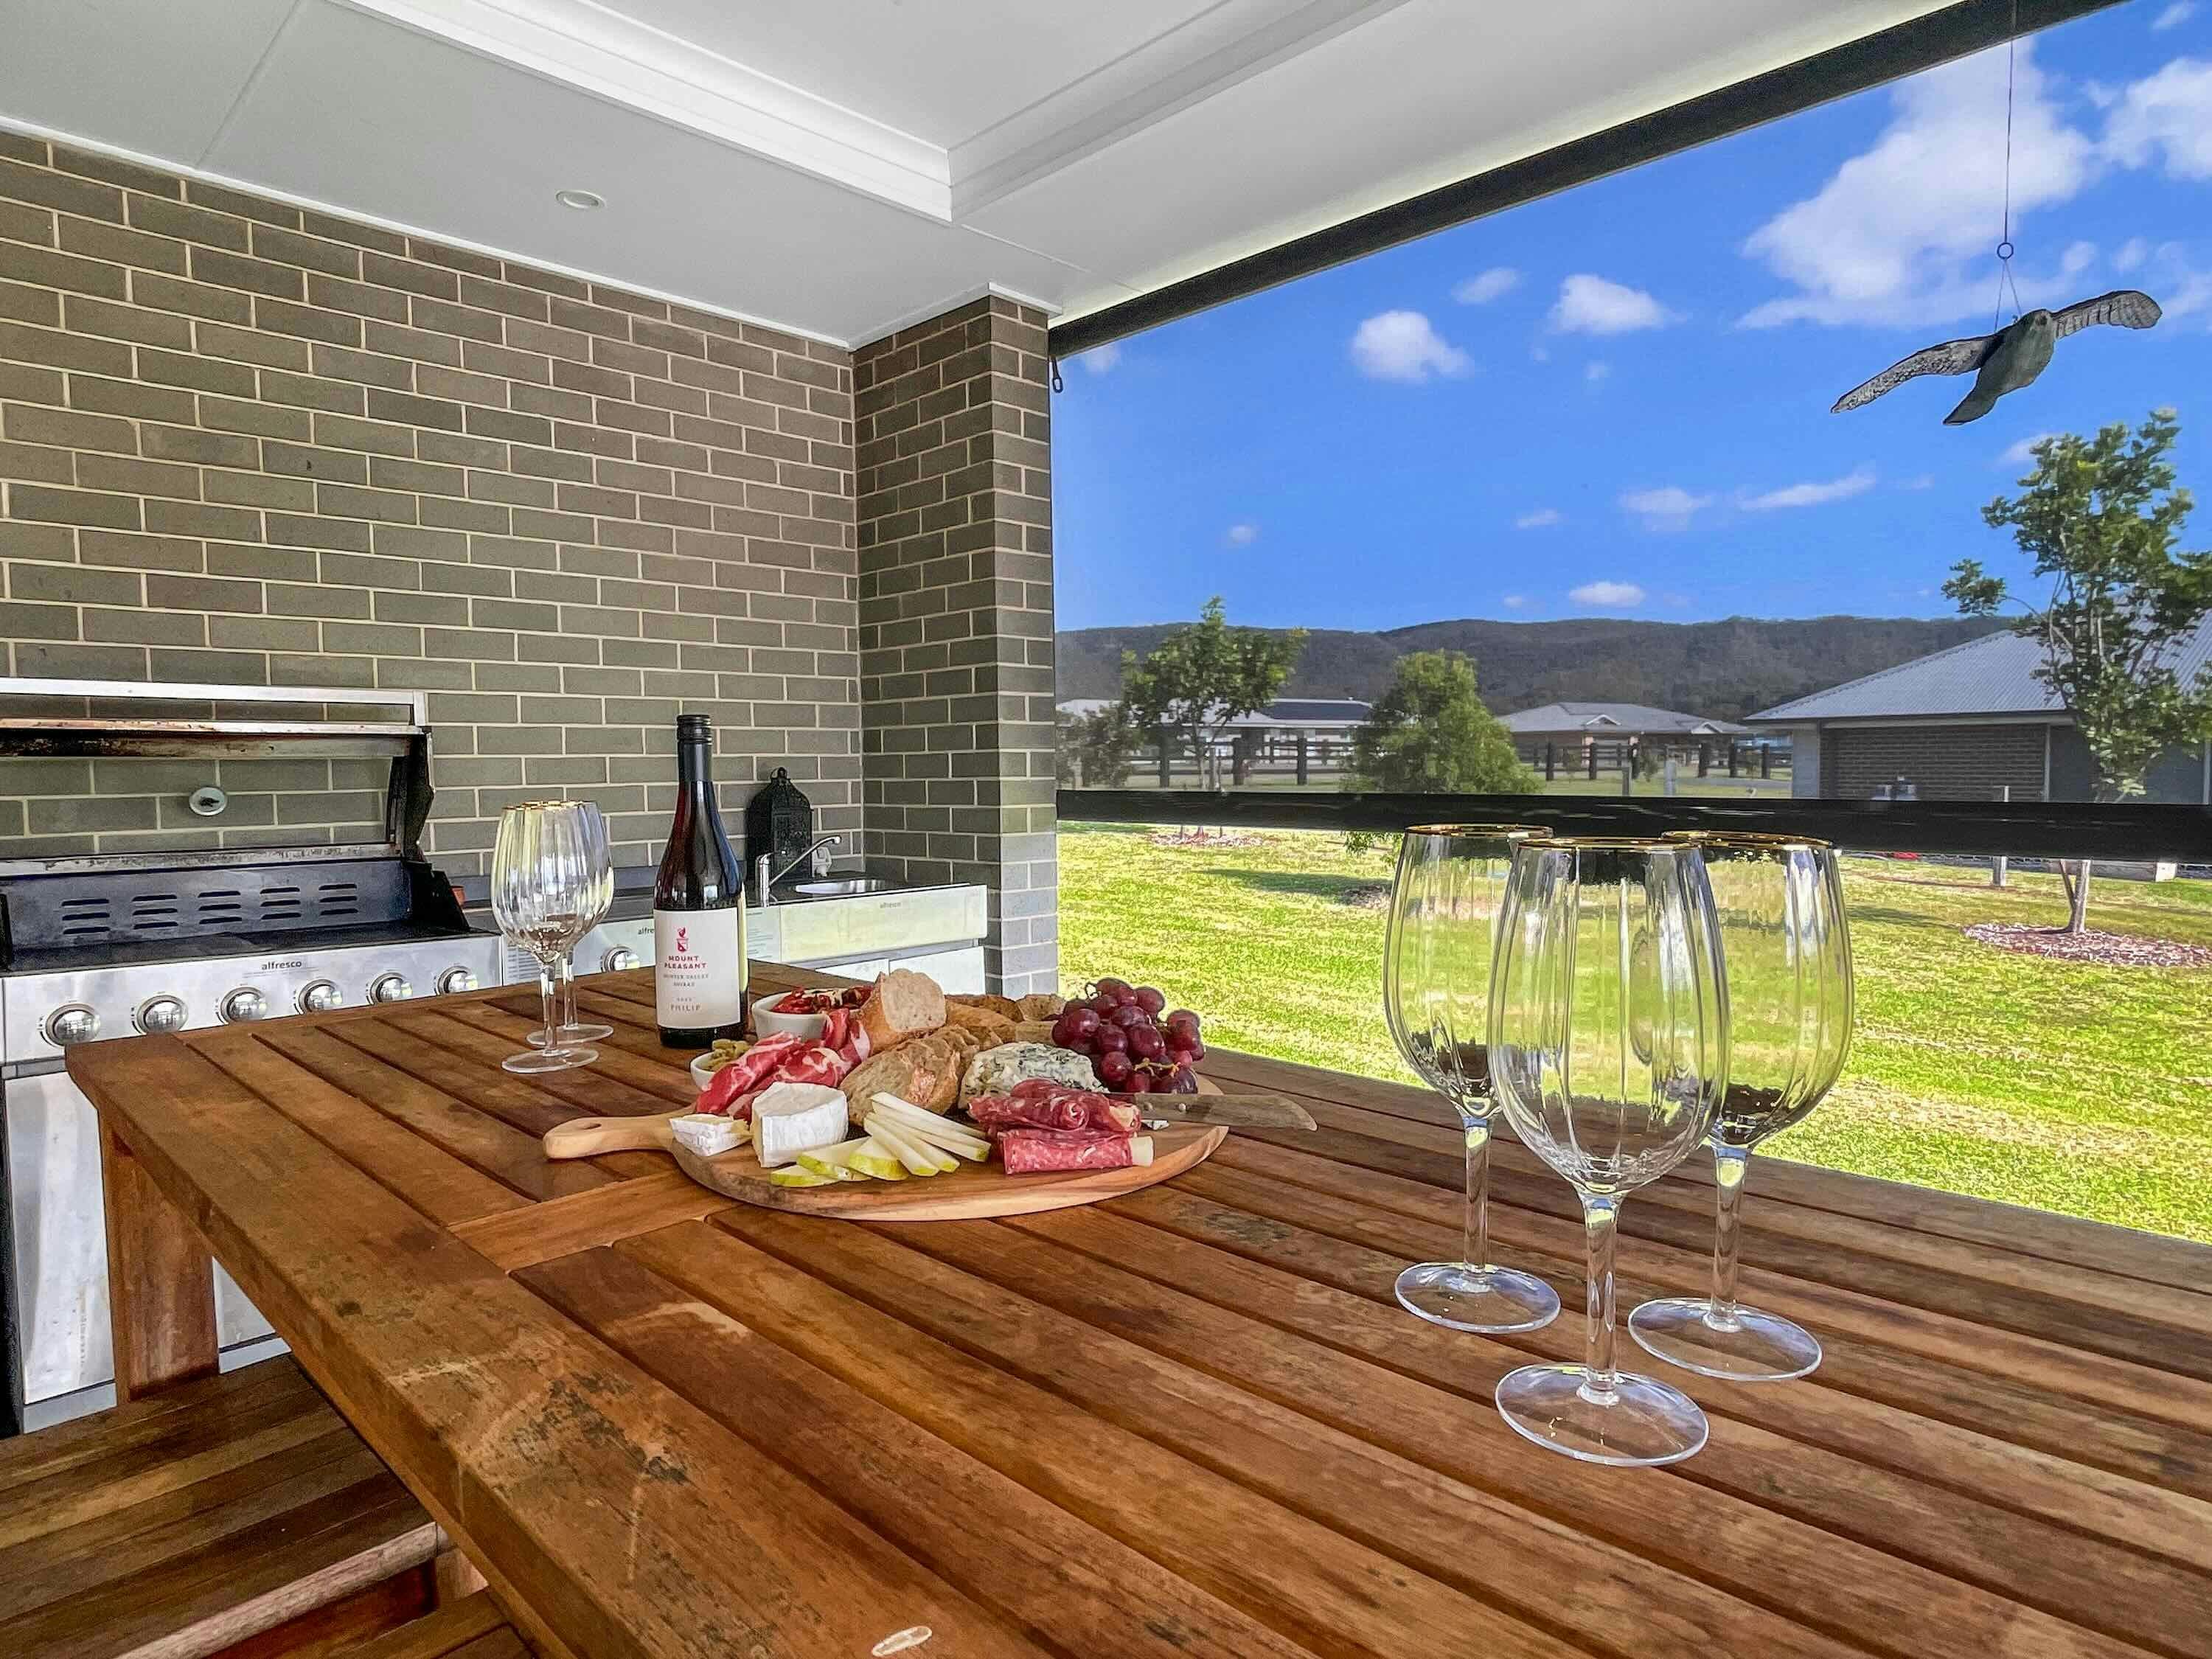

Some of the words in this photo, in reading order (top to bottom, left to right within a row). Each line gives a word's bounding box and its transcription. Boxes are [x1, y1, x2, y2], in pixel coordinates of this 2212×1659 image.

[638, 926, 654, 935] alfre
[262, 961, 302, 970] alfresco
[671, 1004, 700, 1012] PHILIP
